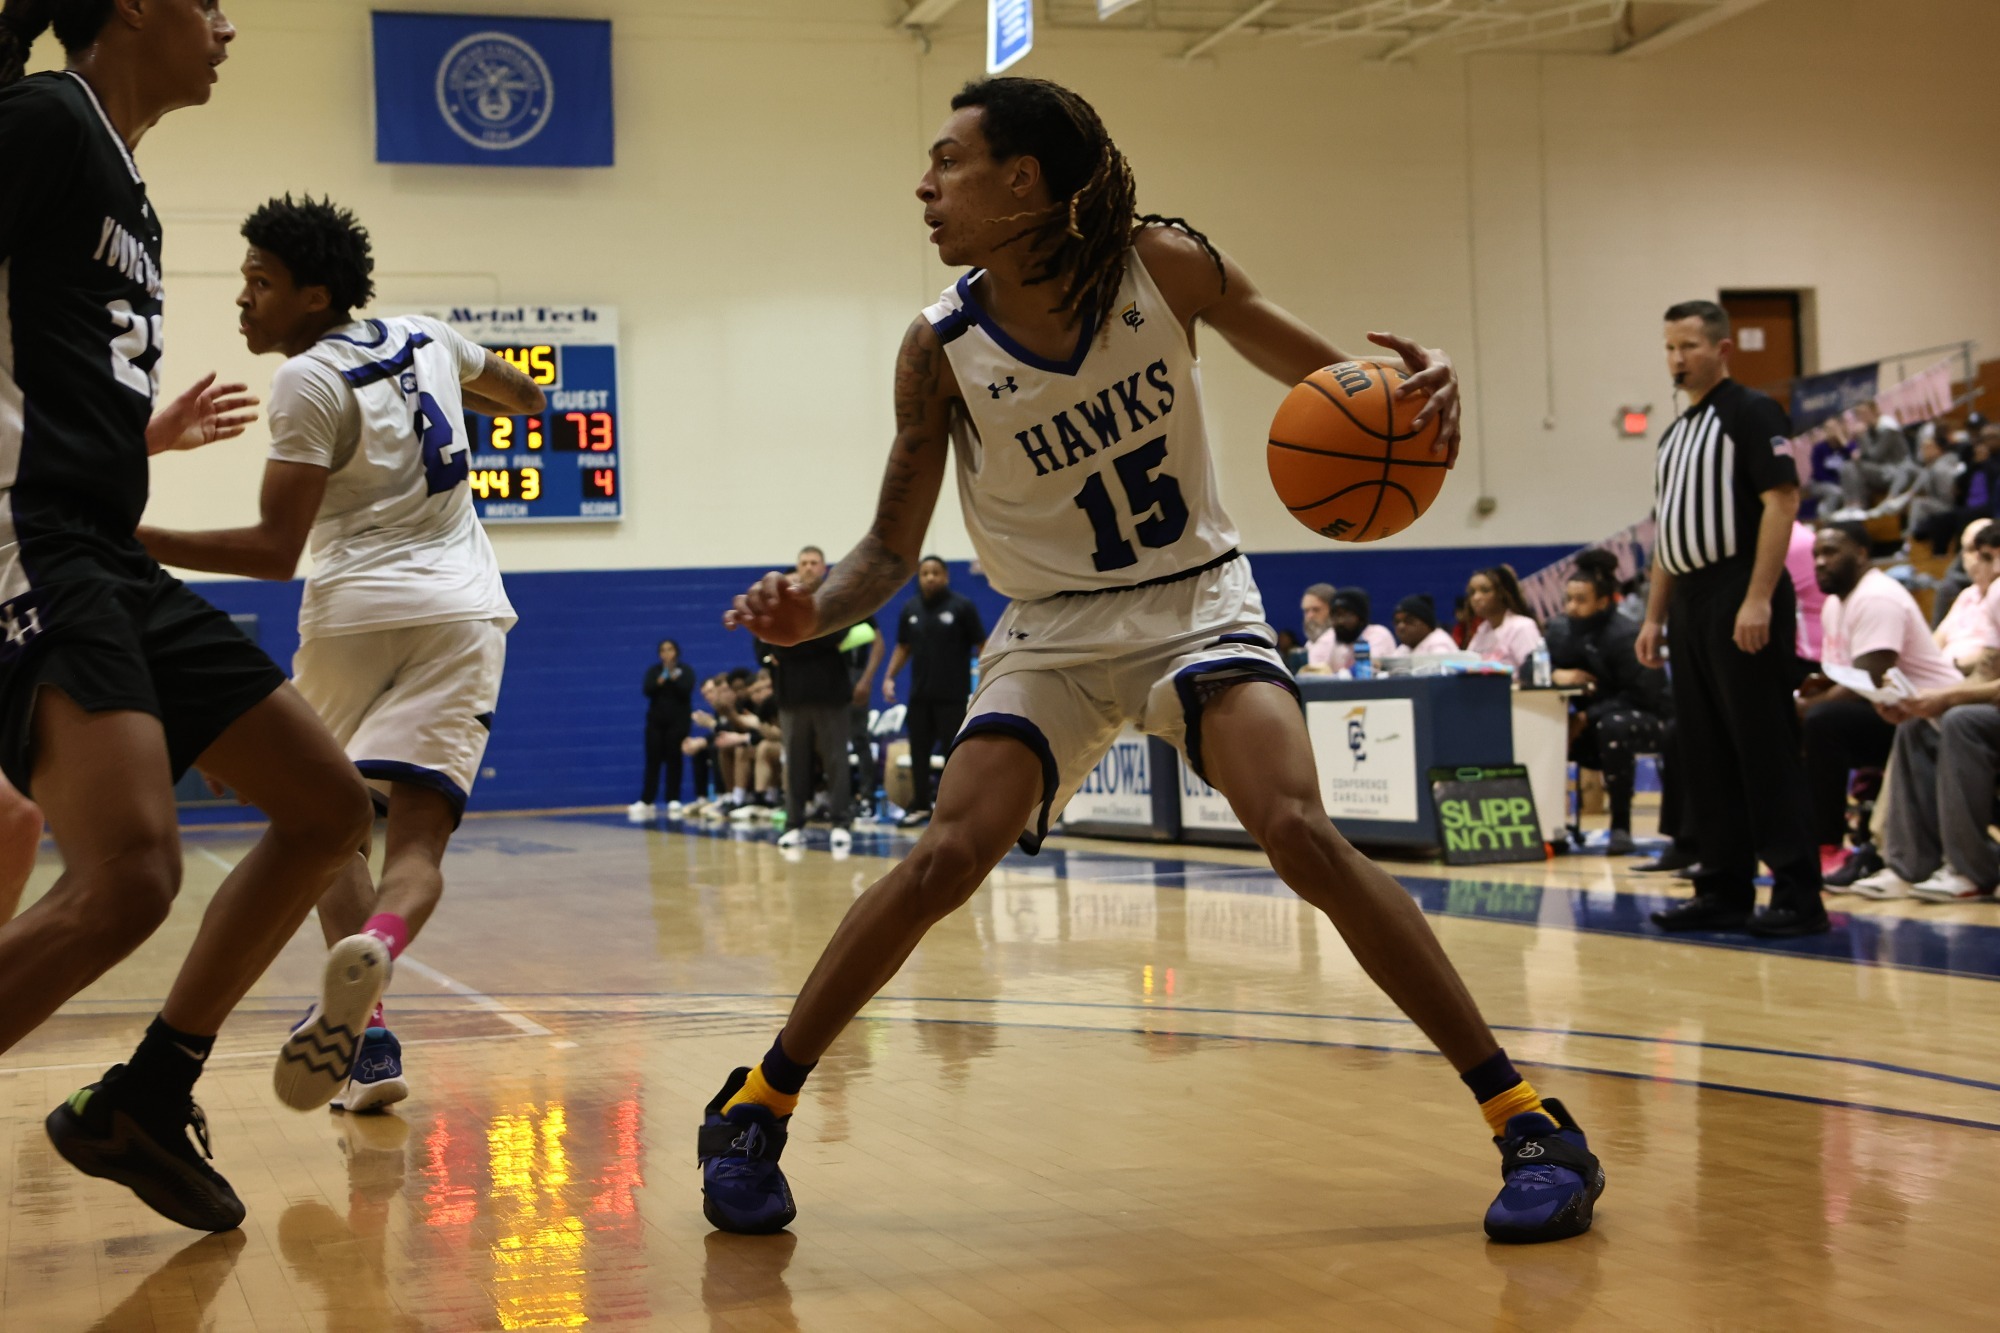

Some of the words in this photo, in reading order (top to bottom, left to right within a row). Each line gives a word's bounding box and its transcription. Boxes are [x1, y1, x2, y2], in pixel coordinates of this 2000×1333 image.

[449, 307, 525, 323] Metal
[531, 306, 598, 323] Tech
[552, 390, 609, 410] GUEST
[491, 416, 513, 449] 2
[565, 412, 613, 451] 73
[1014, 358, 1175, 476] HAWKS
[469, 470, 510, 499] 44
[521, 467, 540, 500] 3
[594, 469, 614, 496] 4
[1074, 434, 1189, 572] 15
[1440, 797, 1531, 828] SLIPP
